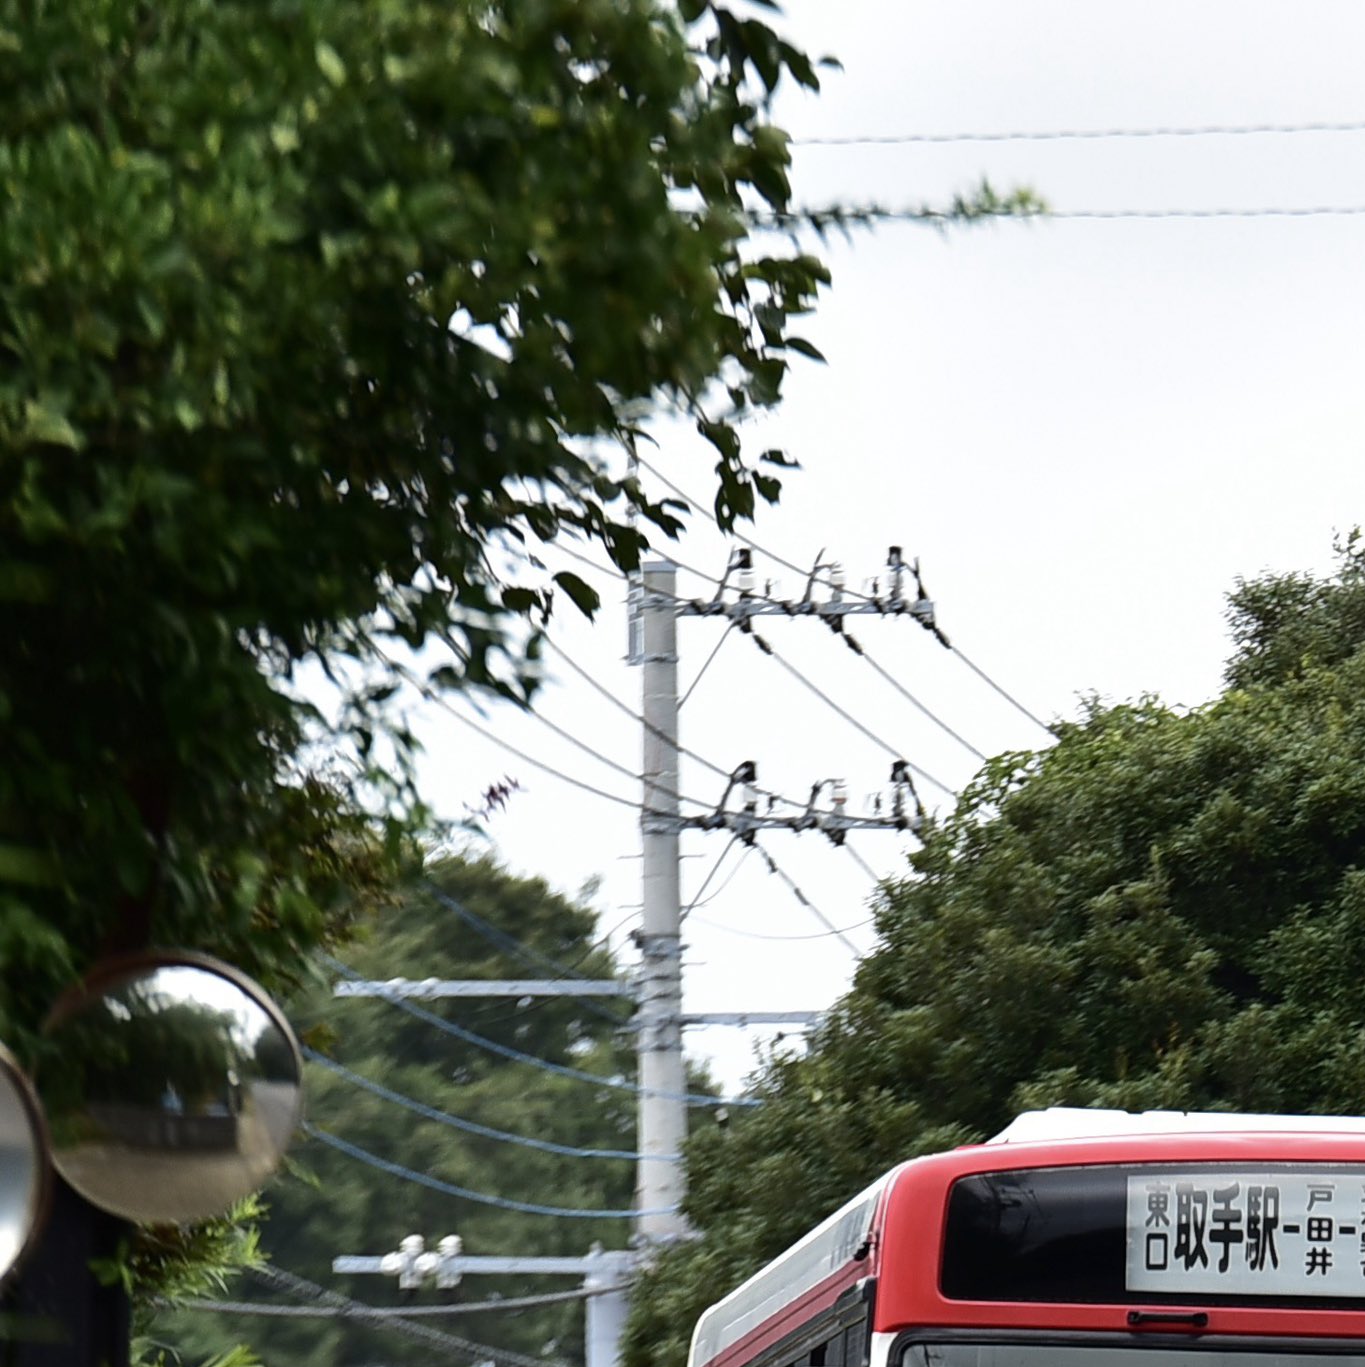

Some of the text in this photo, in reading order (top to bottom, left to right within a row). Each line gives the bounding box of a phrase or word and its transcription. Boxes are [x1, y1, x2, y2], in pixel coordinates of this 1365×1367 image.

[1174, 1182, 1279, 1272] 取手駅
[1305, 1184, 1335, 1276] 戸田井
